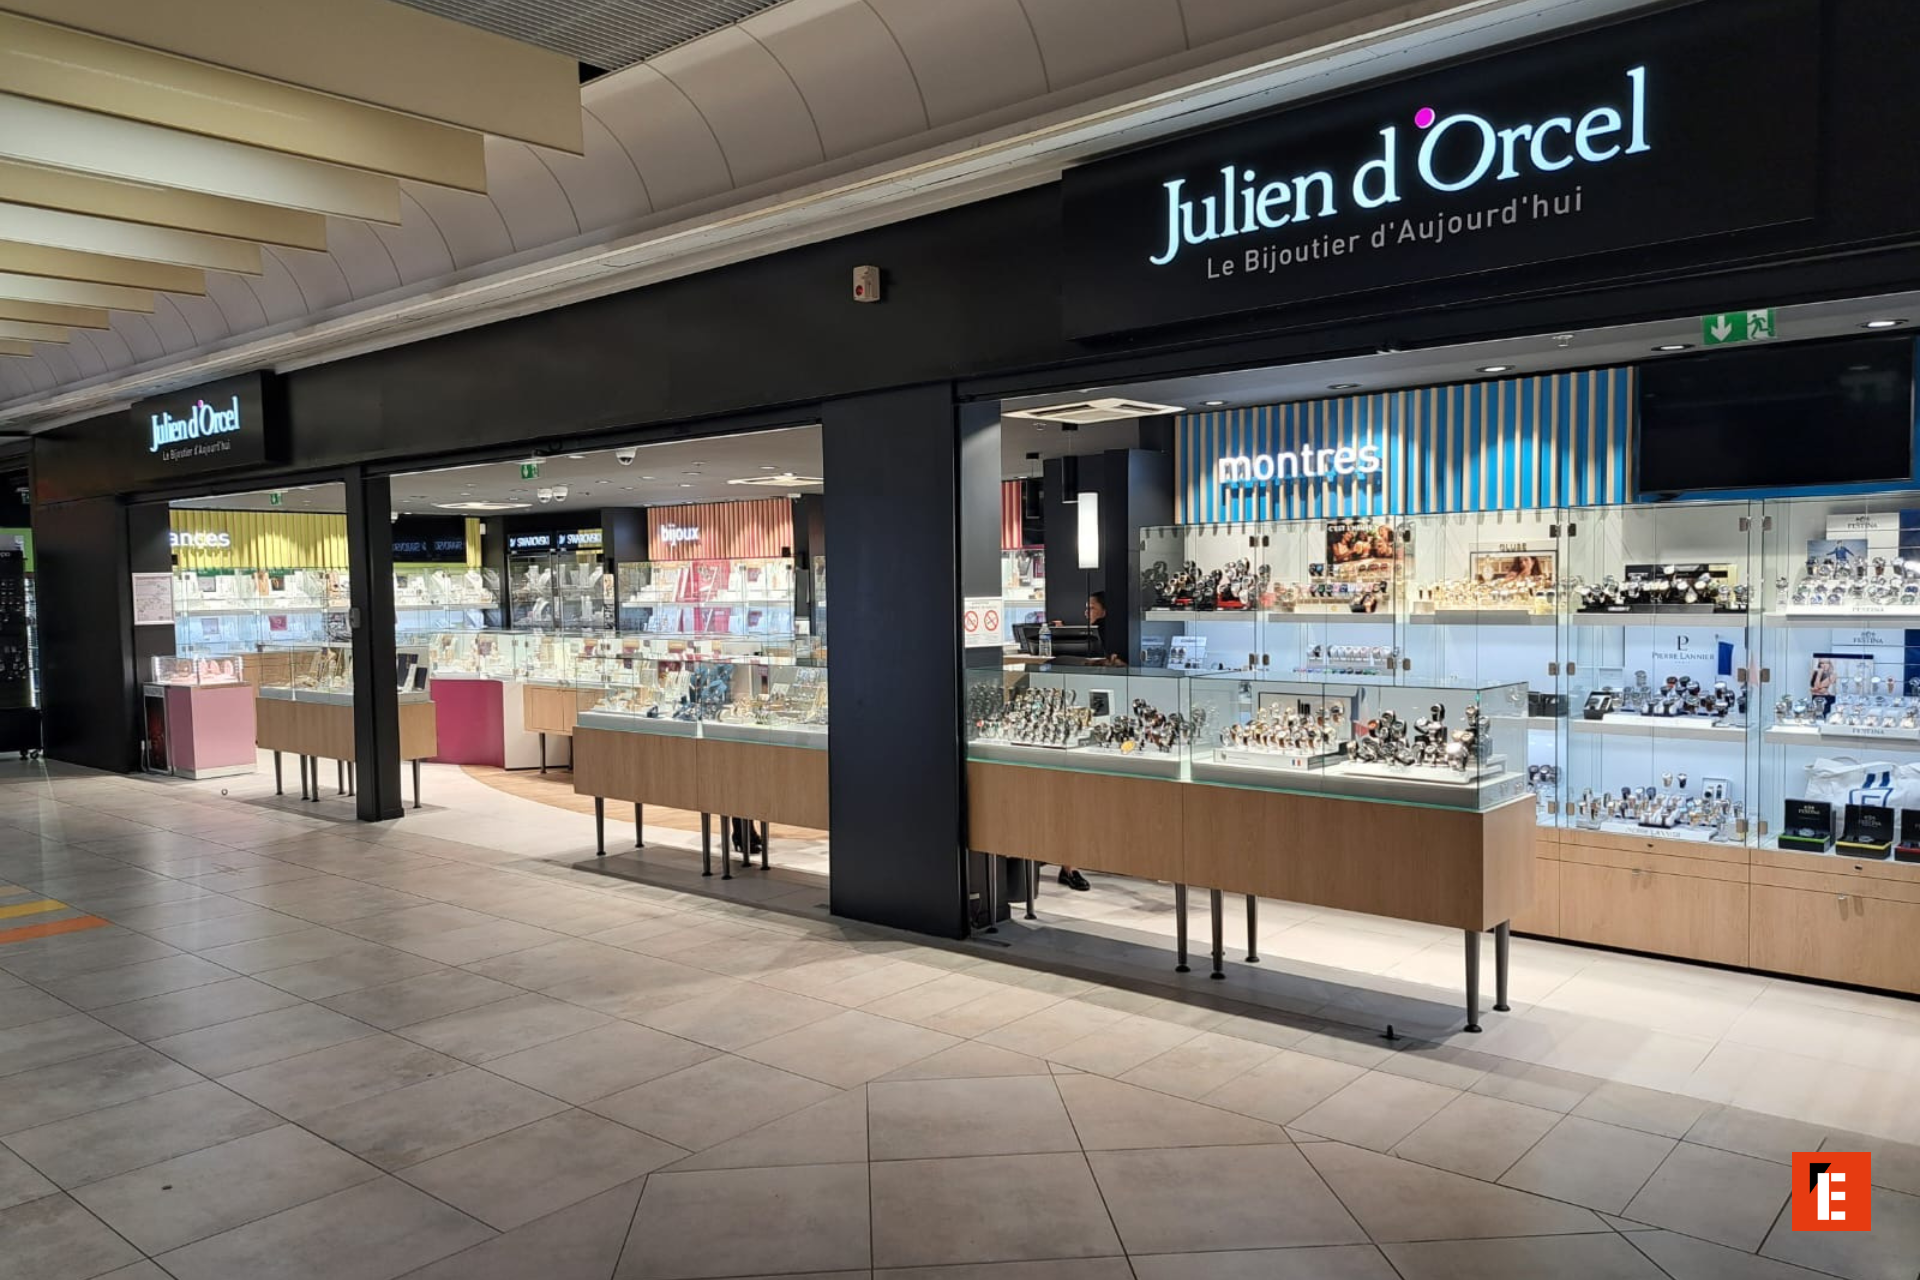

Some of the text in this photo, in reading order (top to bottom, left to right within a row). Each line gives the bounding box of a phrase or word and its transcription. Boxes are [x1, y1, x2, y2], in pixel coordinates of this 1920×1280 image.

[1149, 165, 1338, 265] Julien
[1207, 185, 1583, 279] Le Bijoutier d'Aujourd'hui
[149, 411, 189, 453] Julien
[1218, 443, 1381, 484] montres
[660, 523, 699, 547] bijoux
